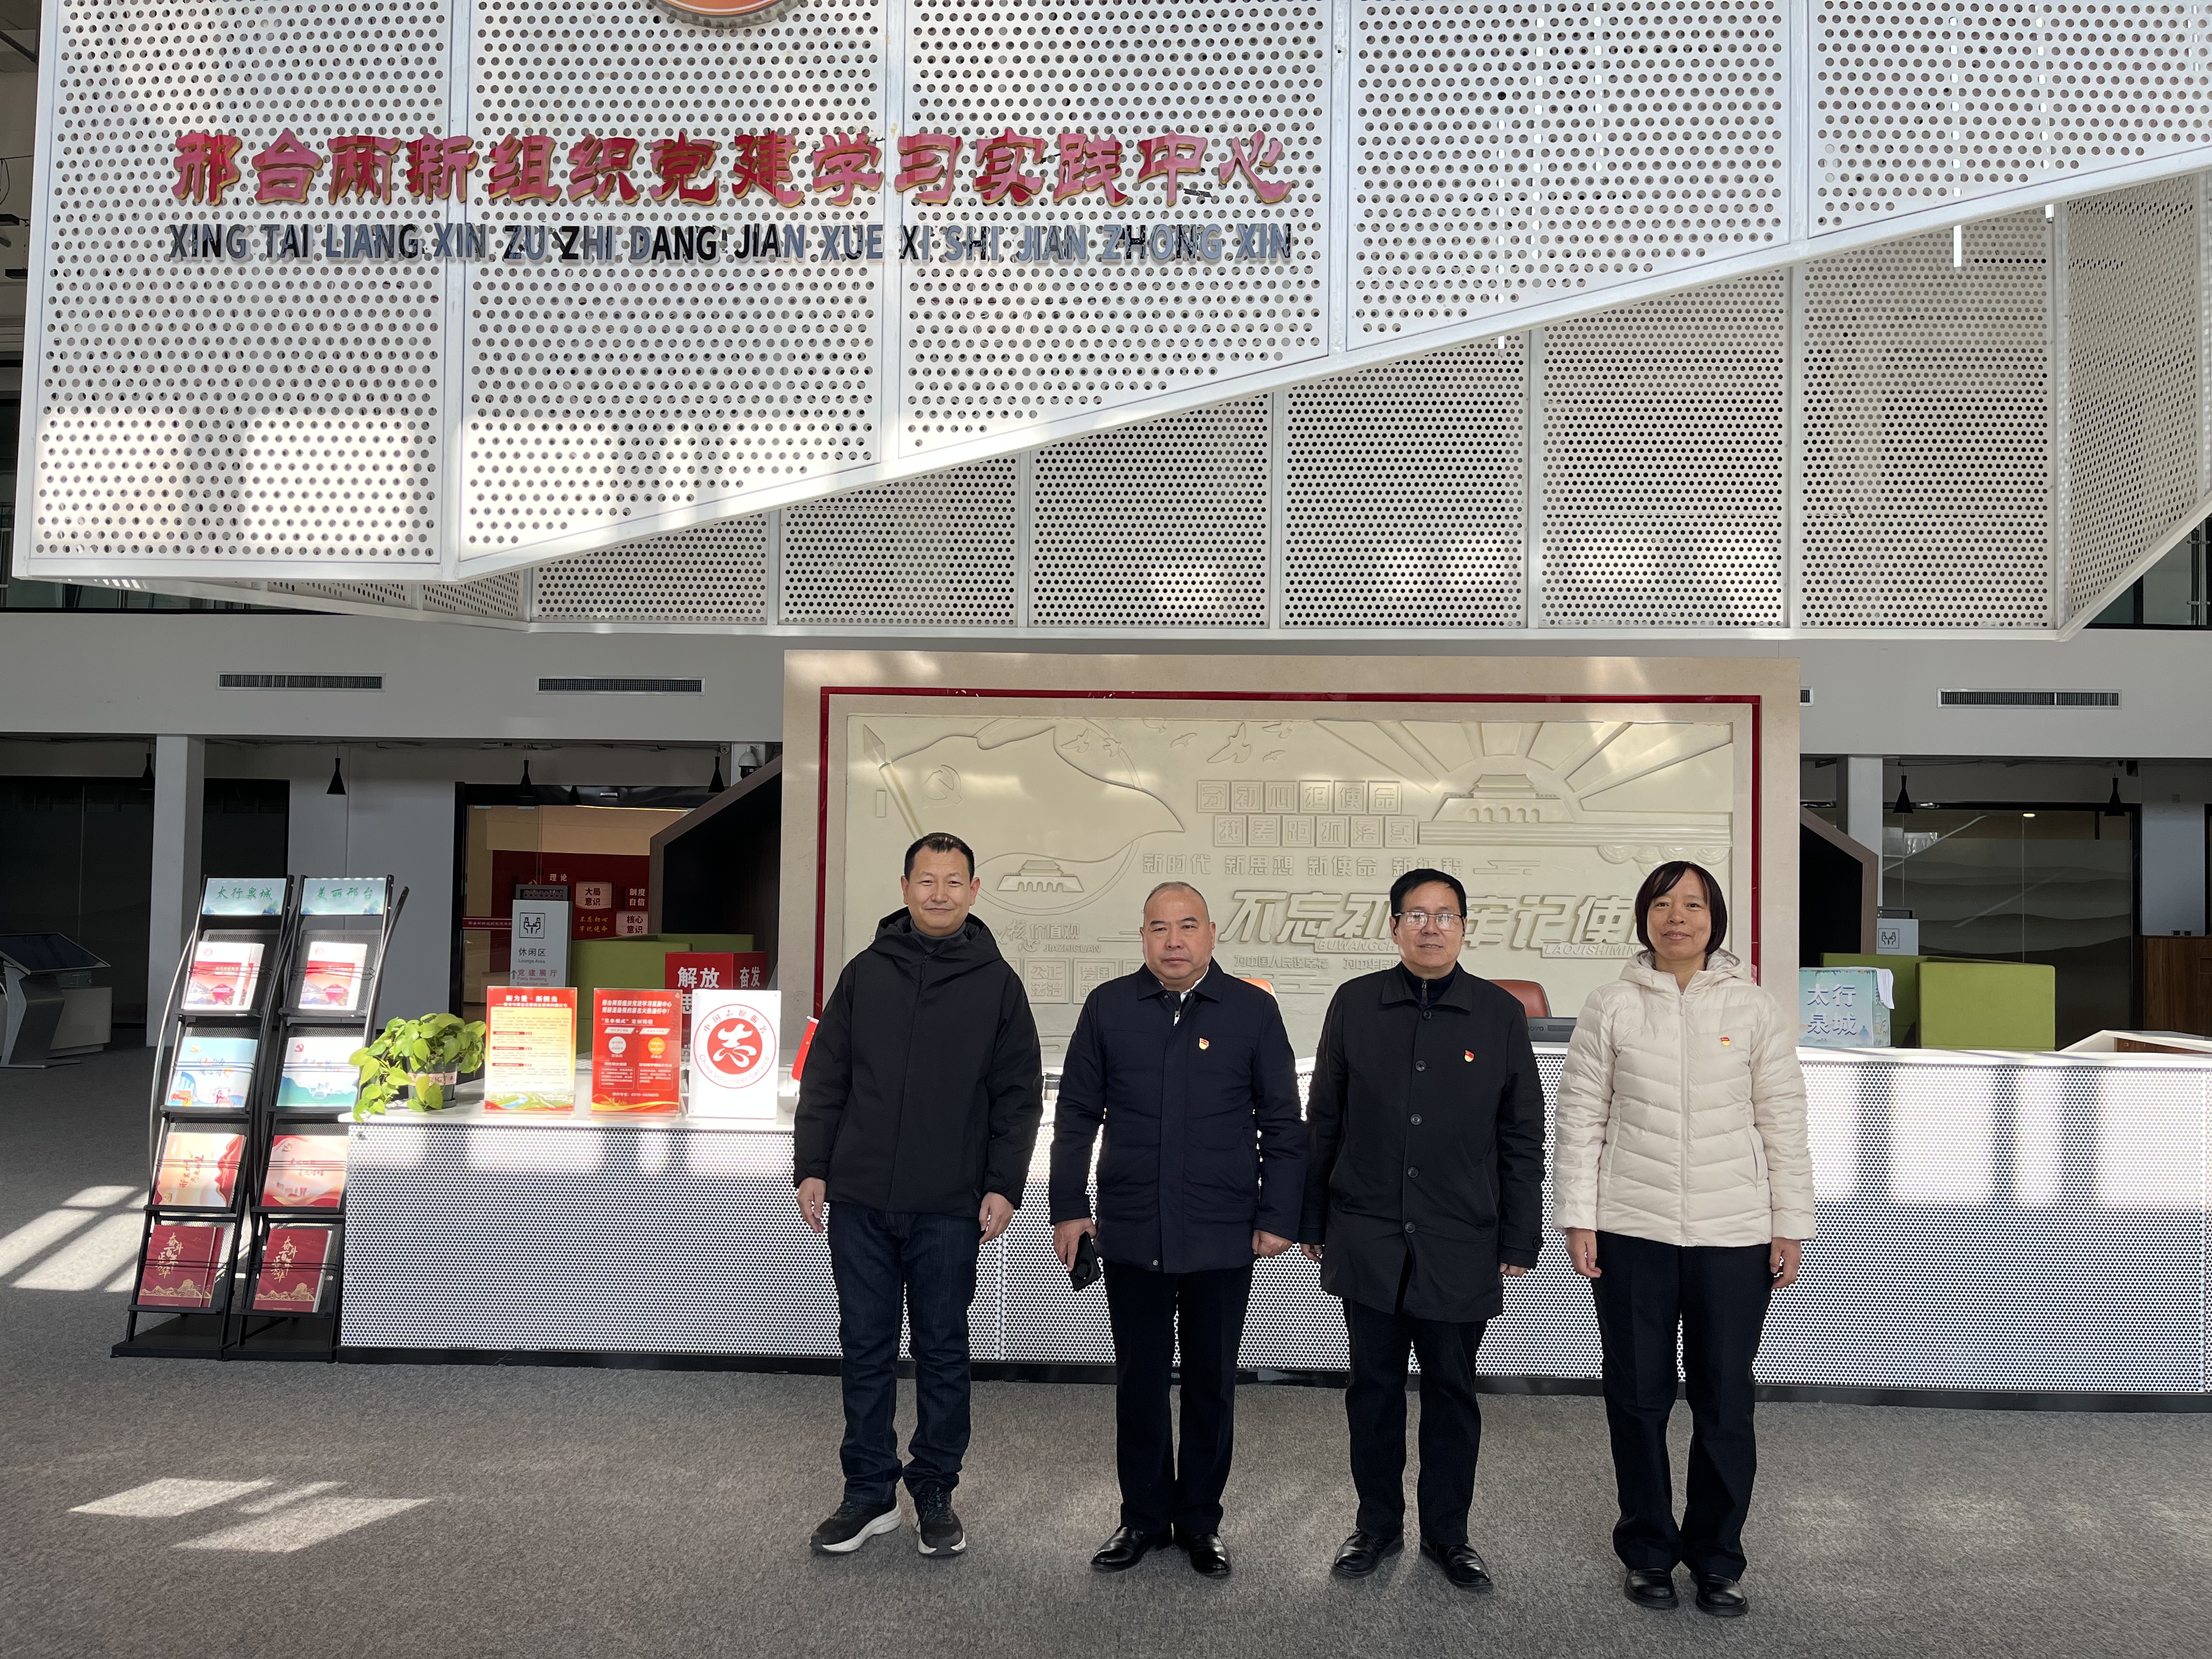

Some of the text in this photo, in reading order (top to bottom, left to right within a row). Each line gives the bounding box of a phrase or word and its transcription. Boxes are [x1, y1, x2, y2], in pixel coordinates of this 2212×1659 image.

[171, 129, 1293, 206] 邢台两新组织党建学习实践中心
[169, 223, 1292, 261] XING TAI LIANG XIN ZU ZHI DANG JIAN XUE XI SHI JIAN ZHONG XIN
[1202, 786, 1396, 809] 守初心担使命
[1219, 820, 1413, 843] 找差距抓落实
[1143, 853, 1211, 875] 新时代
[1224, 855, 1295, 876] 新思想
[1307, 856, 1378, 877] 新使命
[549, 873, 567, 882] 理论
[215, 885, 273, 900] 太行泉城
[315, 886, 373, 901] 美丽邢台
[585, 888, 601, 896] 大局
[629, 888, 646, 896] 制度
[585, 898, 601, 906] 意识
[629, 898, 645, 906] 自信
[627, 916, 644, 924] 核心
[1465, 894, 1639, 949] 牢记使
[579, 925, 608, 933] 牢记使命
[627, 926, 643, 934] 意识
[518, 947, 546, 957] 休闲区
[1043, 944, 1101, 953] JIAZHIGUAN
[1234, 955, 1330, 969] 为中国人民谋幸福
[678, 966, 720, 989] 解放
[740, 966, 760, 988] 奋发
[1030, 965, 1063, 980] 公正
[1080, 966, 1110, 981] 爱国
[1030, 981, 1063, 997] 法治
[1807, 984, 1857, 1007] 太行
[1807, 1011, 1857, 1035] 泉城
[699, 1054, 713, 1074] China
